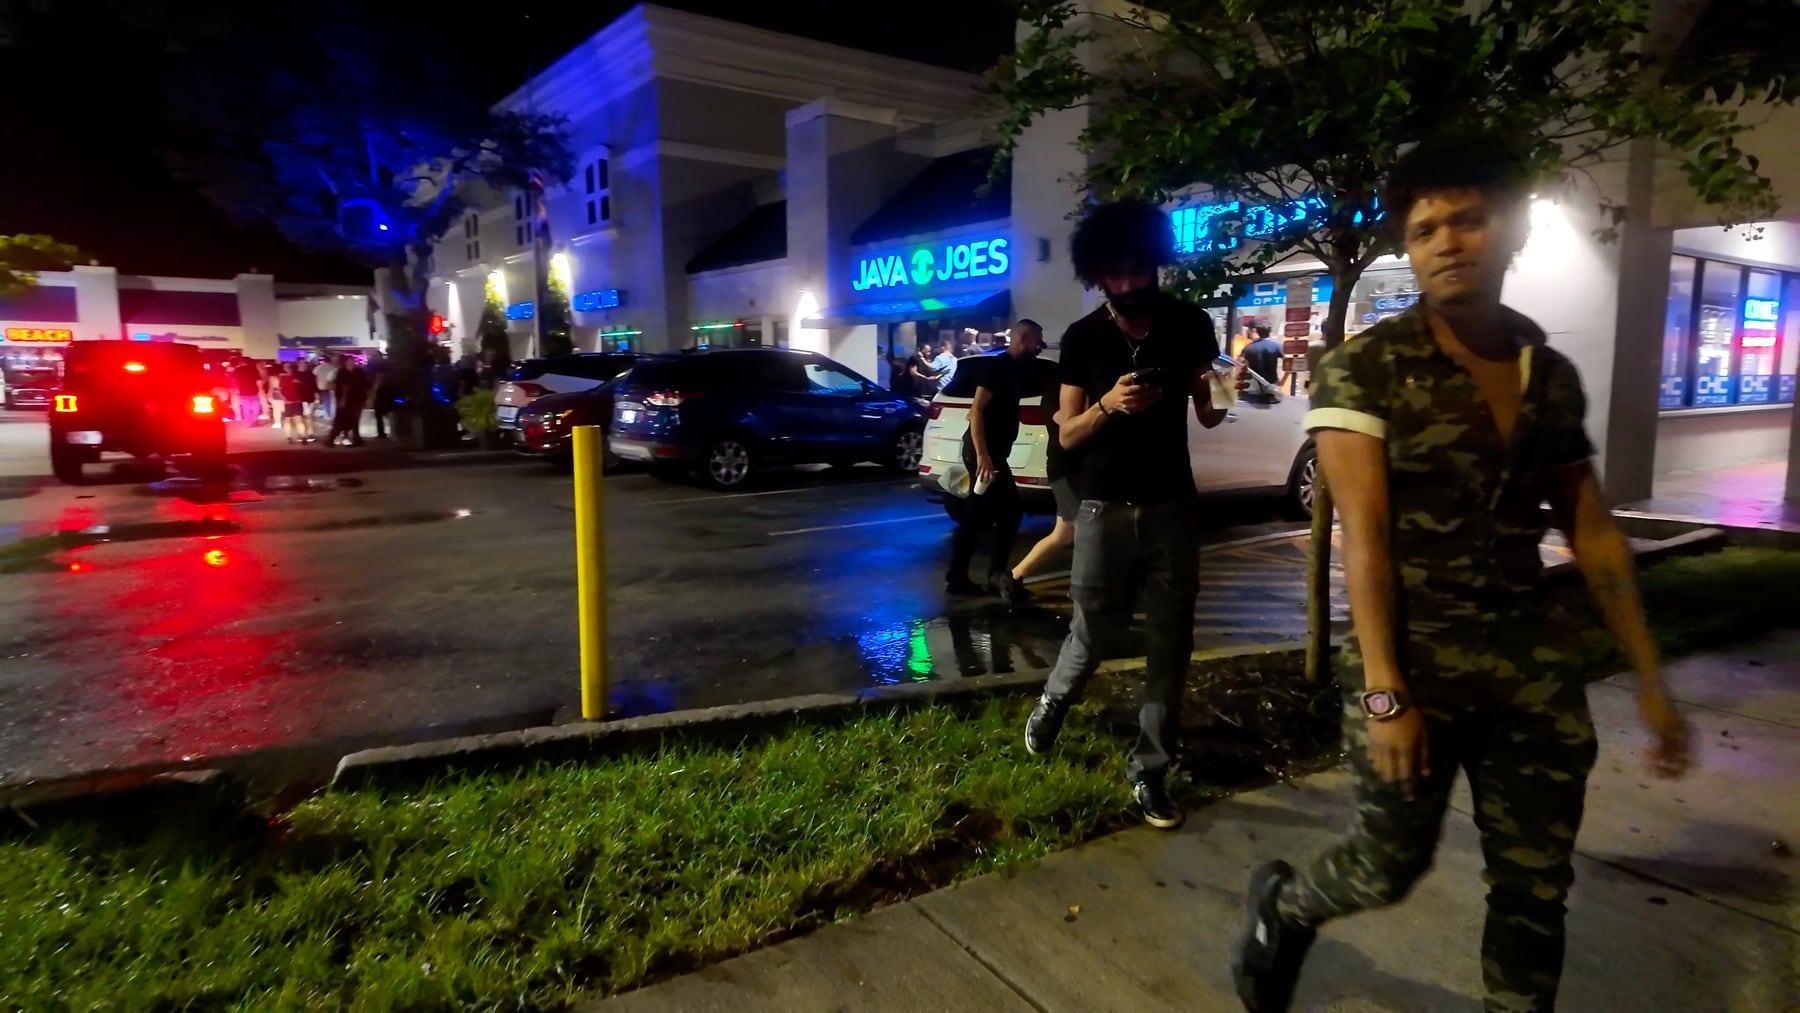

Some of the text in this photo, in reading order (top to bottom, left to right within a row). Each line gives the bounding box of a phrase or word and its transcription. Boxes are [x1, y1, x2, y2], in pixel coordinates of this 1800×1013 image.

[853, 239, 1009, 291] JAVA JOES
[1253, 277, 1319, 297] CH
[1252, 291, 1319, 305] OPTIE
[6, 328, 73, 341] BEACH
